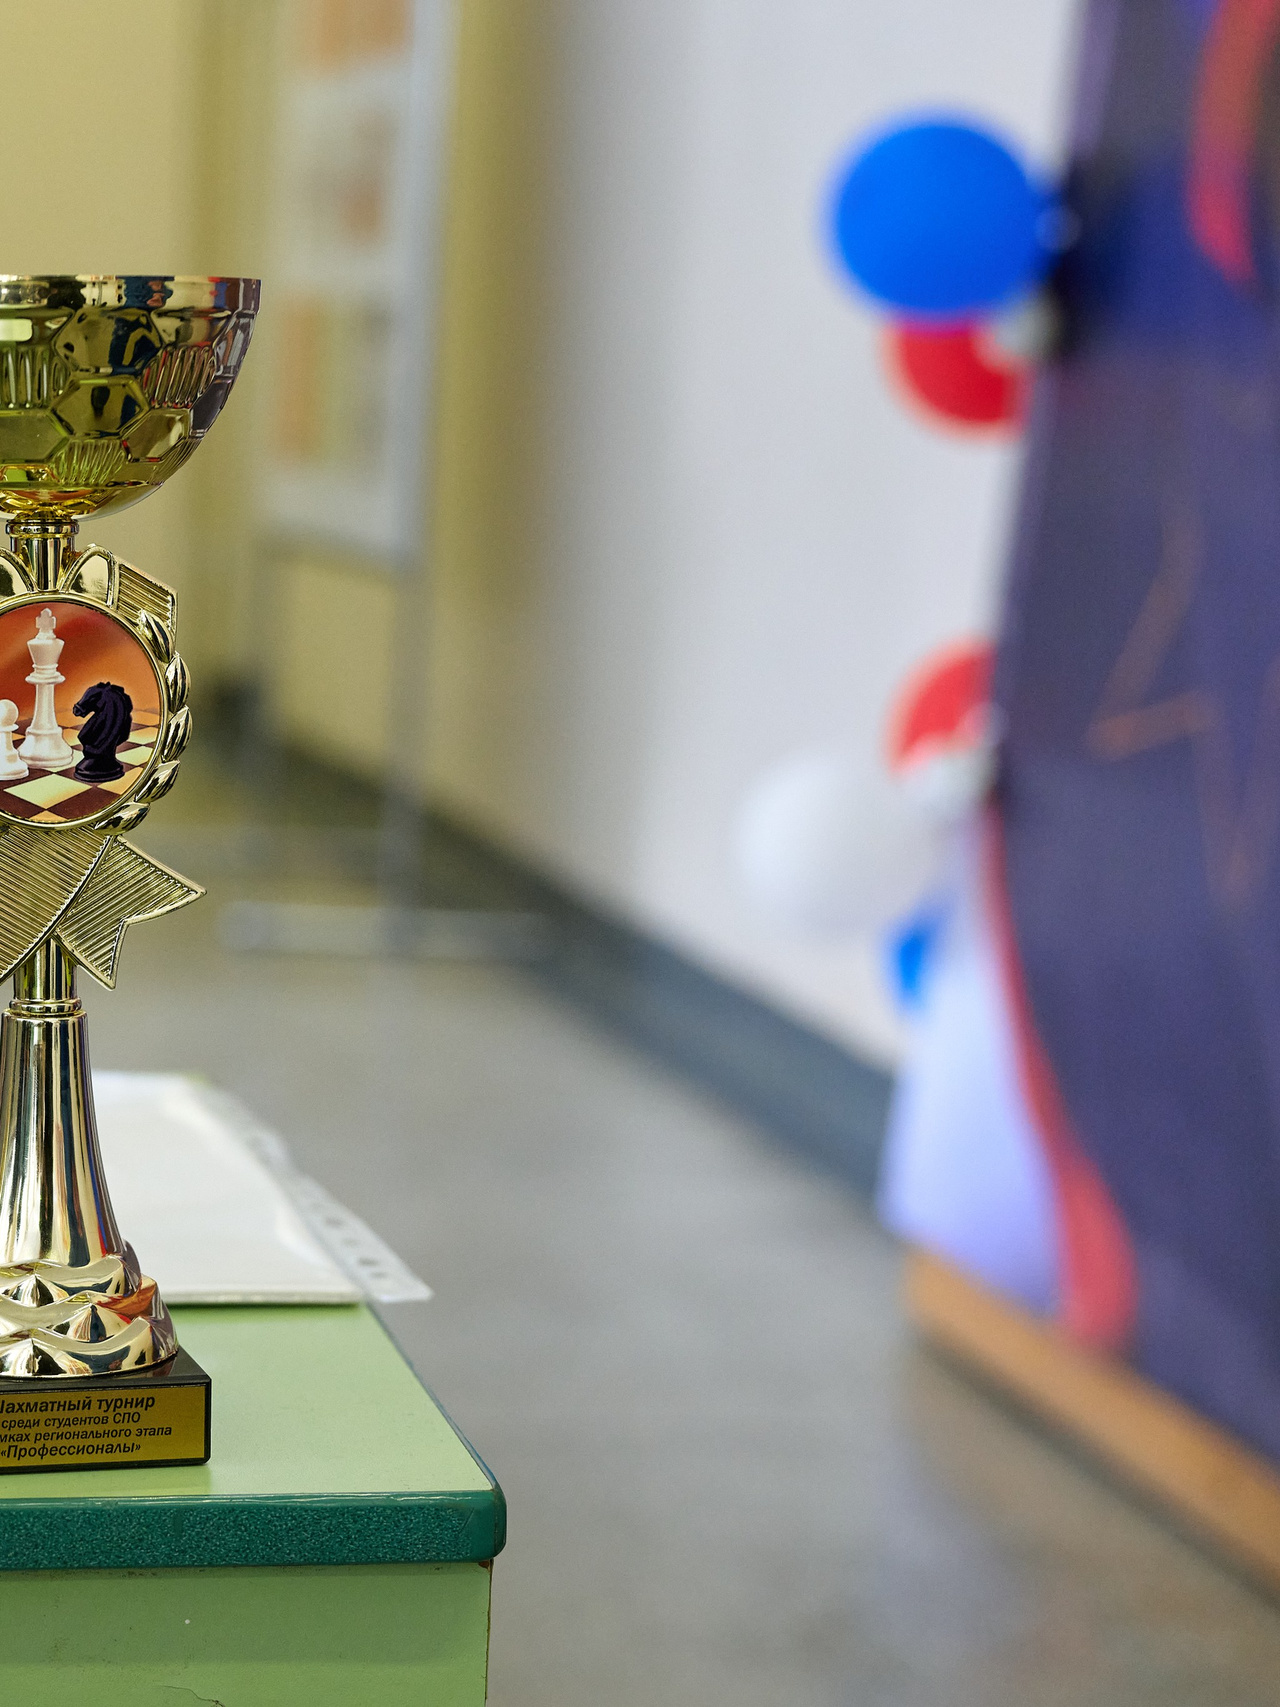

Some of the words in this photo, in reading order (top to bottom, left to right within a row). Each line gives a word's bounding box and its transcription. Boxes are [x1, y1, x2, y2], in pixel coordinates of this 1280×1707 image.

[97, 1396, 155, 1411] турнир
[1, 1418, 40, 1431] среди
[44, 1415, 109, 1428] студентов
[112, 1411, 141, 1424] СПО
[34, 1428, 132, 1443] регионального
[135, 1426, 172, 1437] этапа
[1, 1442, 141, 1460] «Профессионалы»
